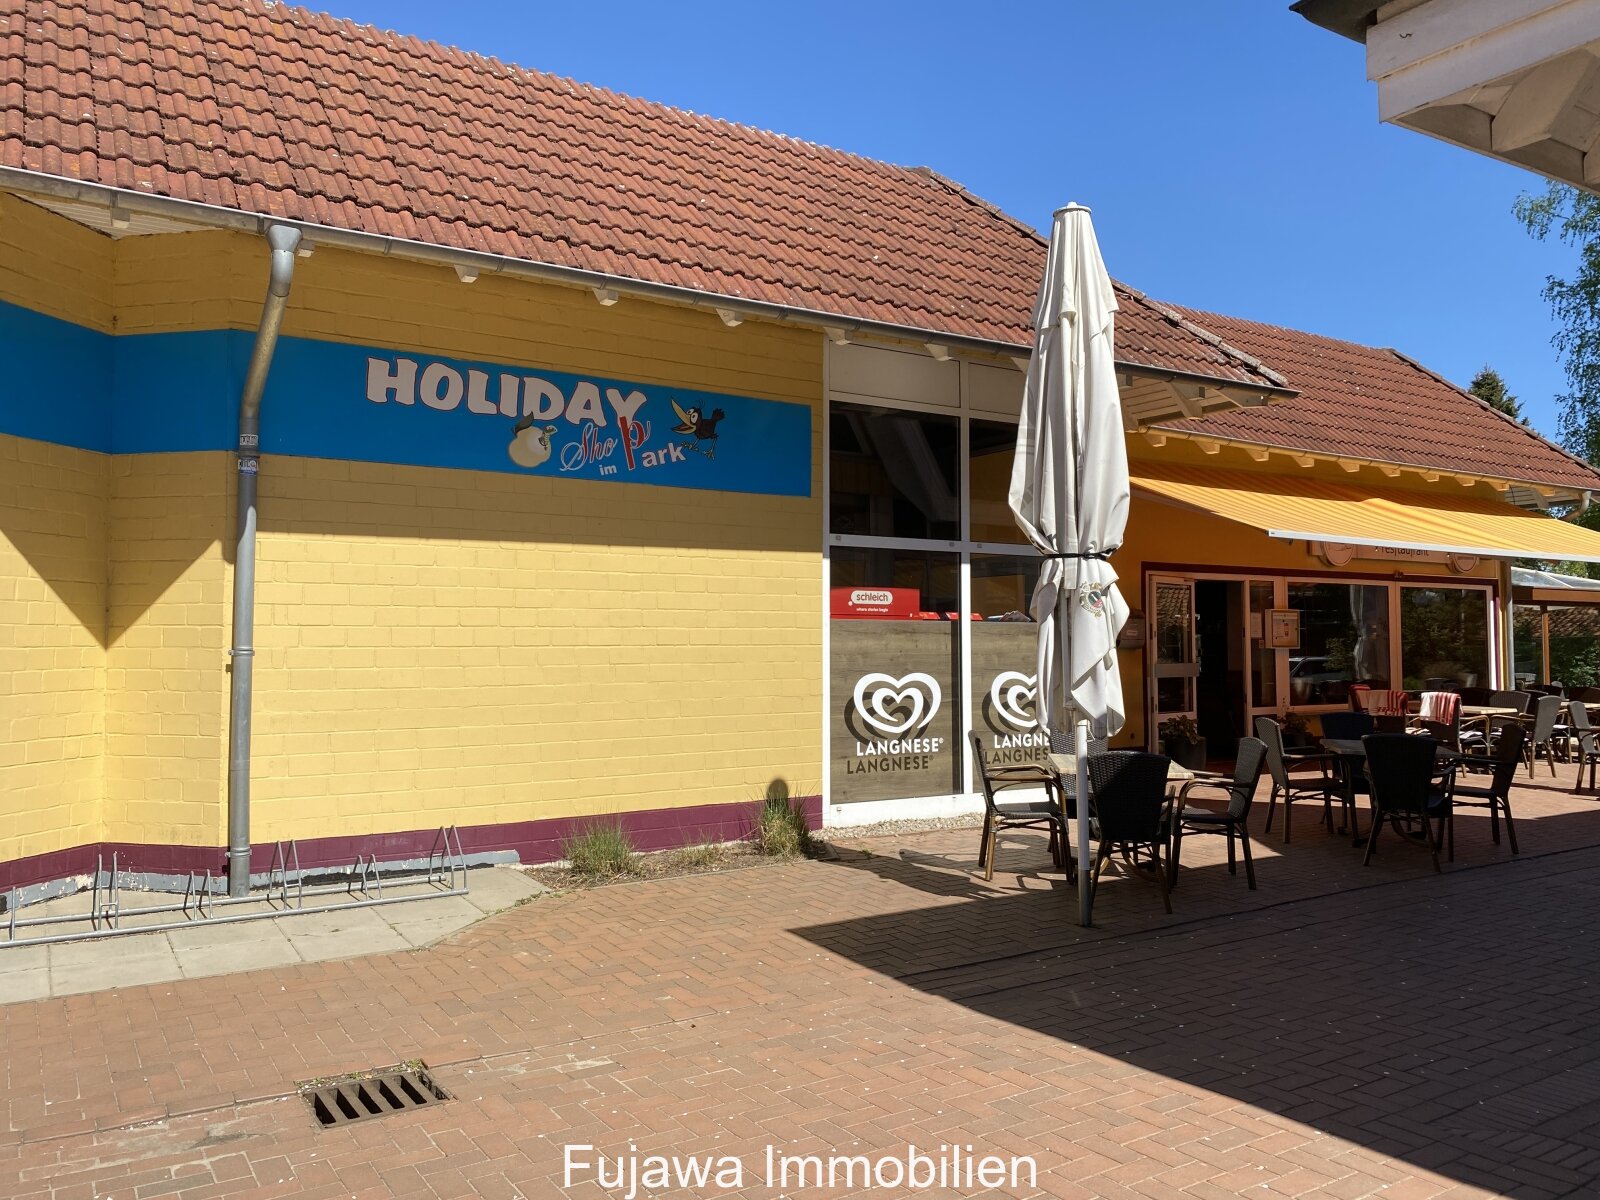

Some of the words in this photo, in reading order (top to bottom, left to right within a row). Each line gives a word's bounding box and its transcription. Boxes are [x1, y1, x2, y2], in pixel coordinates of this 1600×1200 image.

[366, 356, 648, 427] HOLIDAY
[600, 464, 617, 476] im
[856, 592, 889, 602] schleich
[994, 732, 1050, 749] LANGNE
[984, 747, 1049, 765] LANGNES
